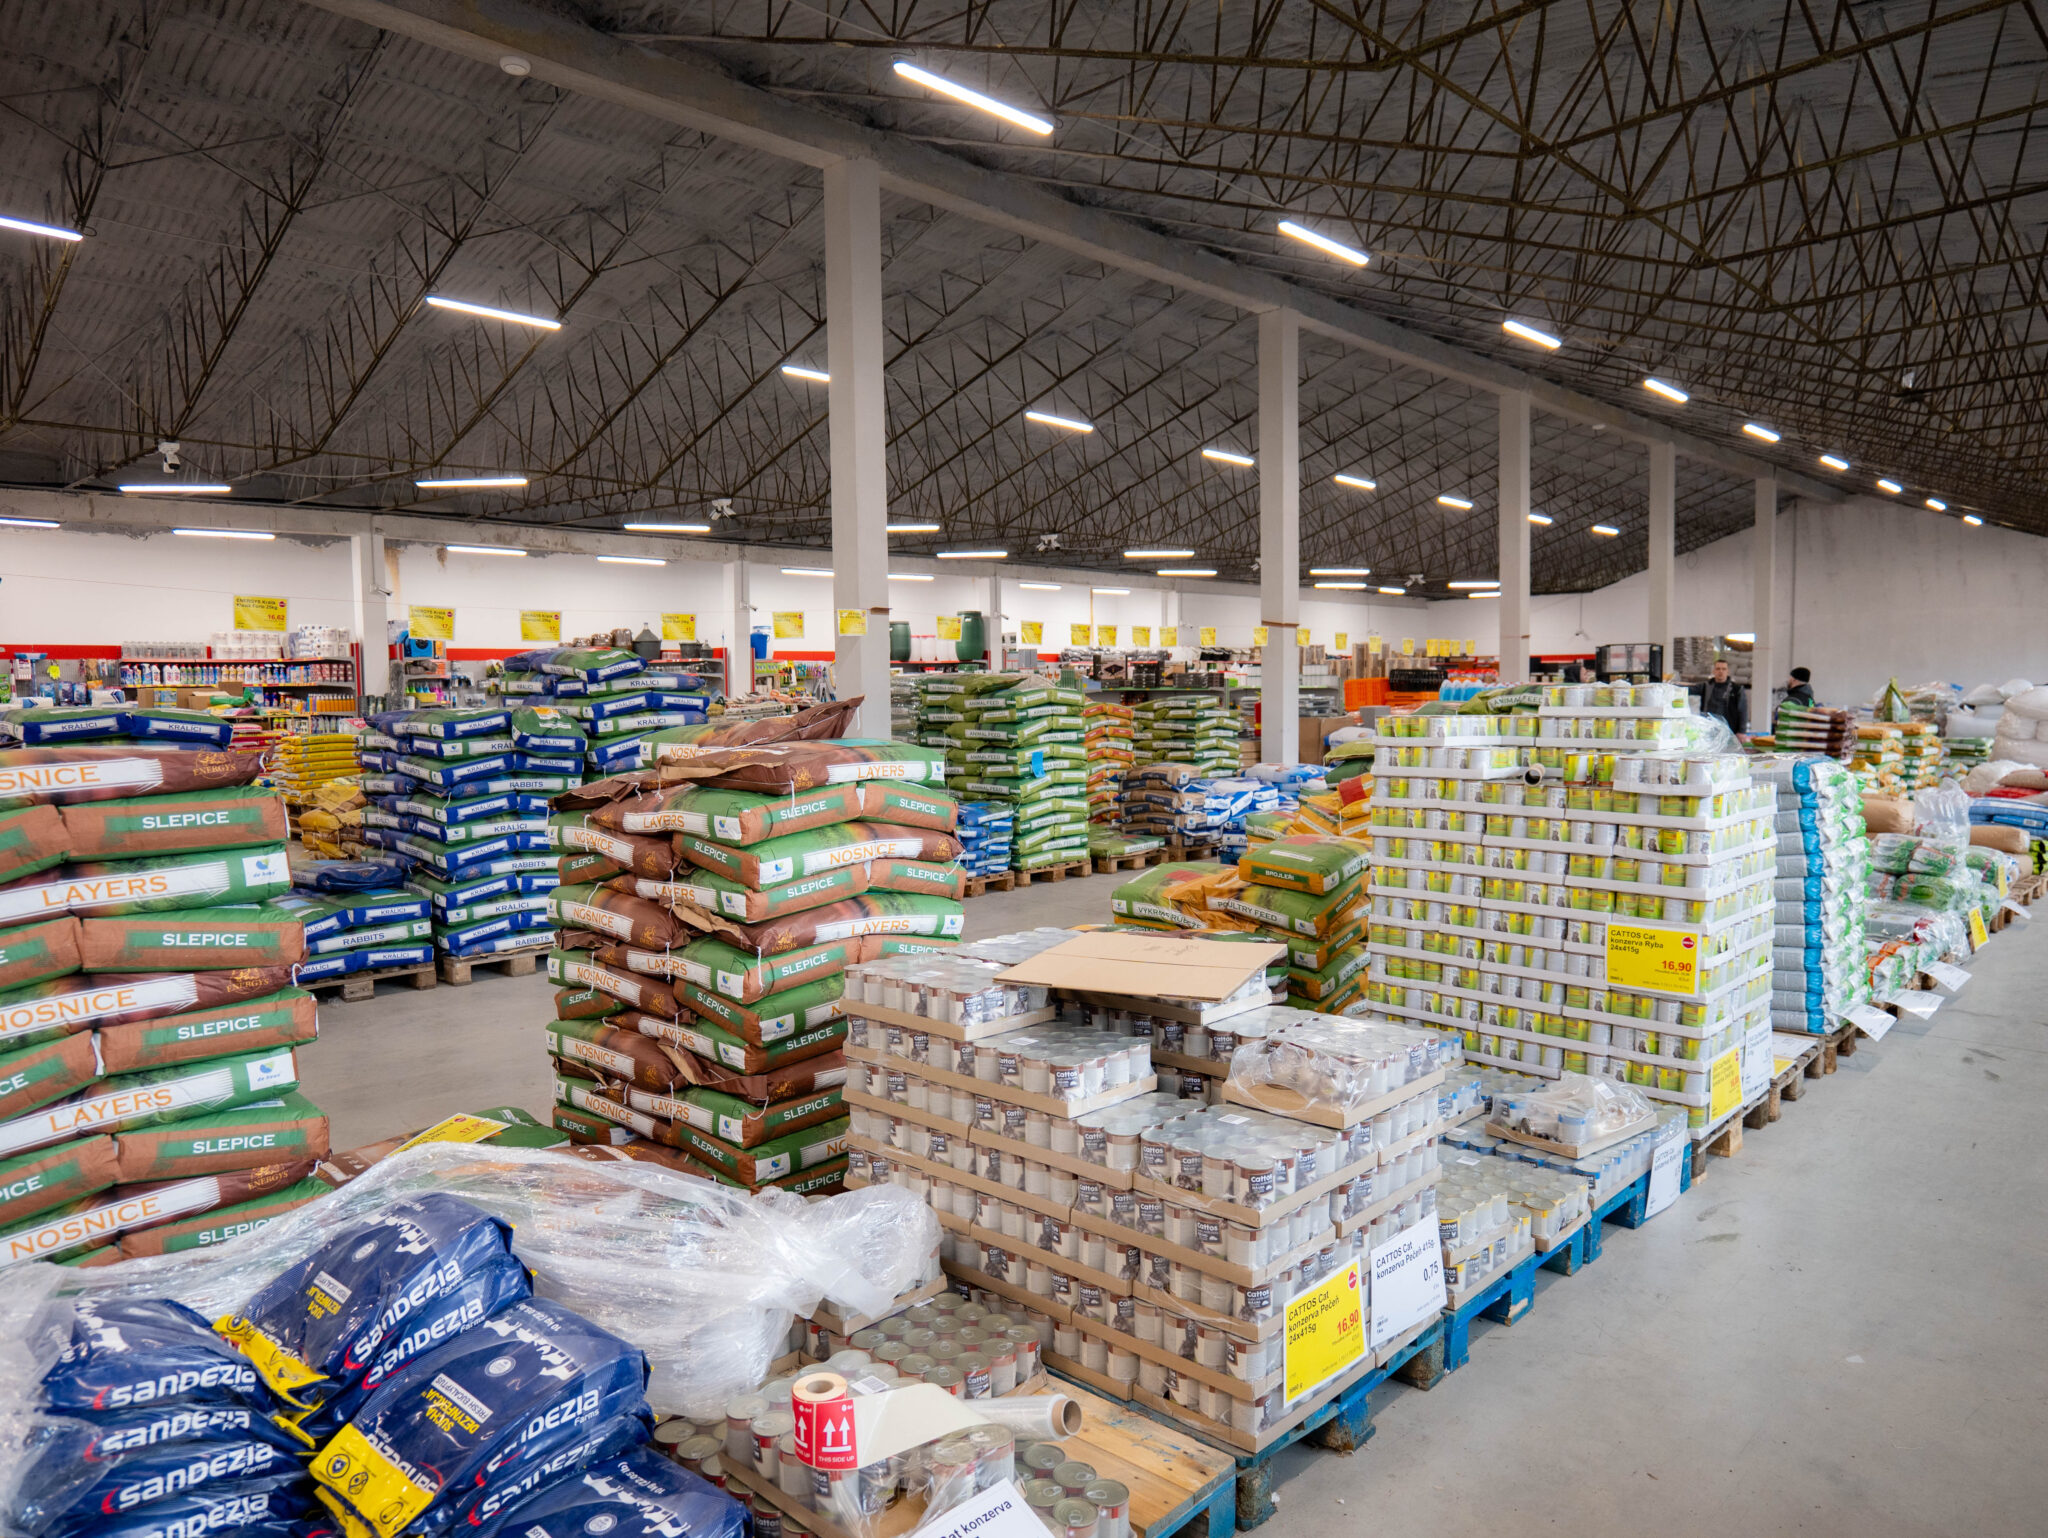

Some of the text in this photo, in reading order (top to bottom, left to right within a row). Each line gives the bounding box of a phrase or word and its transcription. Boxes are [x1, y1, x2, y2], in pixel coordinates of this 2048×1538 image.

[193, 763, 236, 777] ENERGYS
[857, 764, 905, 779] LAYERS
[509, 781, 544, 789] RABBITS
[780, 800, 828, 820] SLEPICE
[899, 797, 937, 815] SLEPICE
[142, 811, 229, 829] SLEPICE
[643, 814, 685, 829] LAYERS
[573, 831, 614, 854] NOSNICE
[694, 840, 728, 864] SLEPICE
[570, 855, 596, 870] SLEPCE
[829, 843, 896, 865] NOSNICE
[511, 860, 547, 869] RABBITS
[907, 866, 946, 883] SLEPICE
[41, 876, 168, 907] LAYERS
[654, 884, 695, 902] LAYERS
[787, 875, 835, 898] SLEPICE
[573, 908, 614, 929] NOSNICE
[1218, 901, 1278, 922] POULTRY FEED
[851, 919, 911, 936] LAYERS
[1610, 929, 1641, 939] CATTOS
[162, 933, 248, 946] SLEPICE
[342, 932, 385, 946] RABBITS
[515, 935, 550, 947] RABBITS
[1610, 937, 1664, 949] konzerva Ryba
[1610, 944, 1640, 954] 24x415g
[646, 957, 688, 976] LAYERS
[781, 952, 829, 977] SLEPICE
[1661, 960, 1692, 972] 16,90
[577, 966, 621, 993] NOSNICE
[569, 991, 592, 1005] SLEPICE
[697, 991, 731, 1018] SLEPICE
[177, 1015, 262, 1040] SLEPICE
[786, 1026, 835, 1050] SLEPICE
[1213, 1035, 1233, 1043] Cattos
[575, 1043, 617, 1067] NOSNICE
[50, 1088, 173, 1132] LAYERS
[585, 1095, 633, 1125] NOSNICE
[650, 1098, 690, 1121] LAYERS
[783, 1096, 830, 1121] SLEPICE
[561, 1118, 587, 1134] SLEPICE
[192, 1134, 275, 1155] SLEPICE
[691, 1135, 725, 1162] SLEPICE
[1143, 1146, 1164, 1154] Cattos
[247, 1170, 289, 1191] ENERGYS
[795, 1171, 842, 1193] SLEPICE
[1250, 1173, 1273, 1183] Cattos
[1079, 1184, 1099, 1192] Cattos
[1140, 1203, 1162, 1211] Cattos
[10, 1197, 162, 1260] NOSNICE
[199, 1218, 275, 1244] SLEPIC
[1197, 1222, 1218, 1232] Cattos
[1376, 1241, 1413, 1269] CATTOS Cat
[1376, 1239, 1435, 1280] konzerva Pečeň 415g
[1423, 1260, 1438, 1281] 0,75
[1080, 1287, 1099, 1296] Cattos
[1246, 1289, 1270, 1298] Cattos
[1288, 1290, 1329, 1322] CATTOS Cat
[1288, 1295, 1340, 1333] konzerva Pečeň
[460, 1314, 486, 1334] Farms
[544, 1317, 555, 1327] kg
[551, 1323, 562, 1331] 10
[1337, 1309, 1359, 1336] 16,90
[1288, 1323, 1317, 1345] 24x415g
[967, 1374, 989, 1385] Cattos
[436, 1375, 488, 1420] FRESH EUCALYPTUS
[425, 1388, 480, 1435] DEZYNFEKCJA
[425, 1406, 455, 1432] SUCHA
[574, 1408, 600, 1426] Farms
[240, 1460, 273, 1476] Farms
[818, 1455, 832, 1463] THIS
[647, 1482, 659, 1491] kg
[654, 1487, 666, 1495] 10
[960, 1500, 1013, 1534] konzerva
